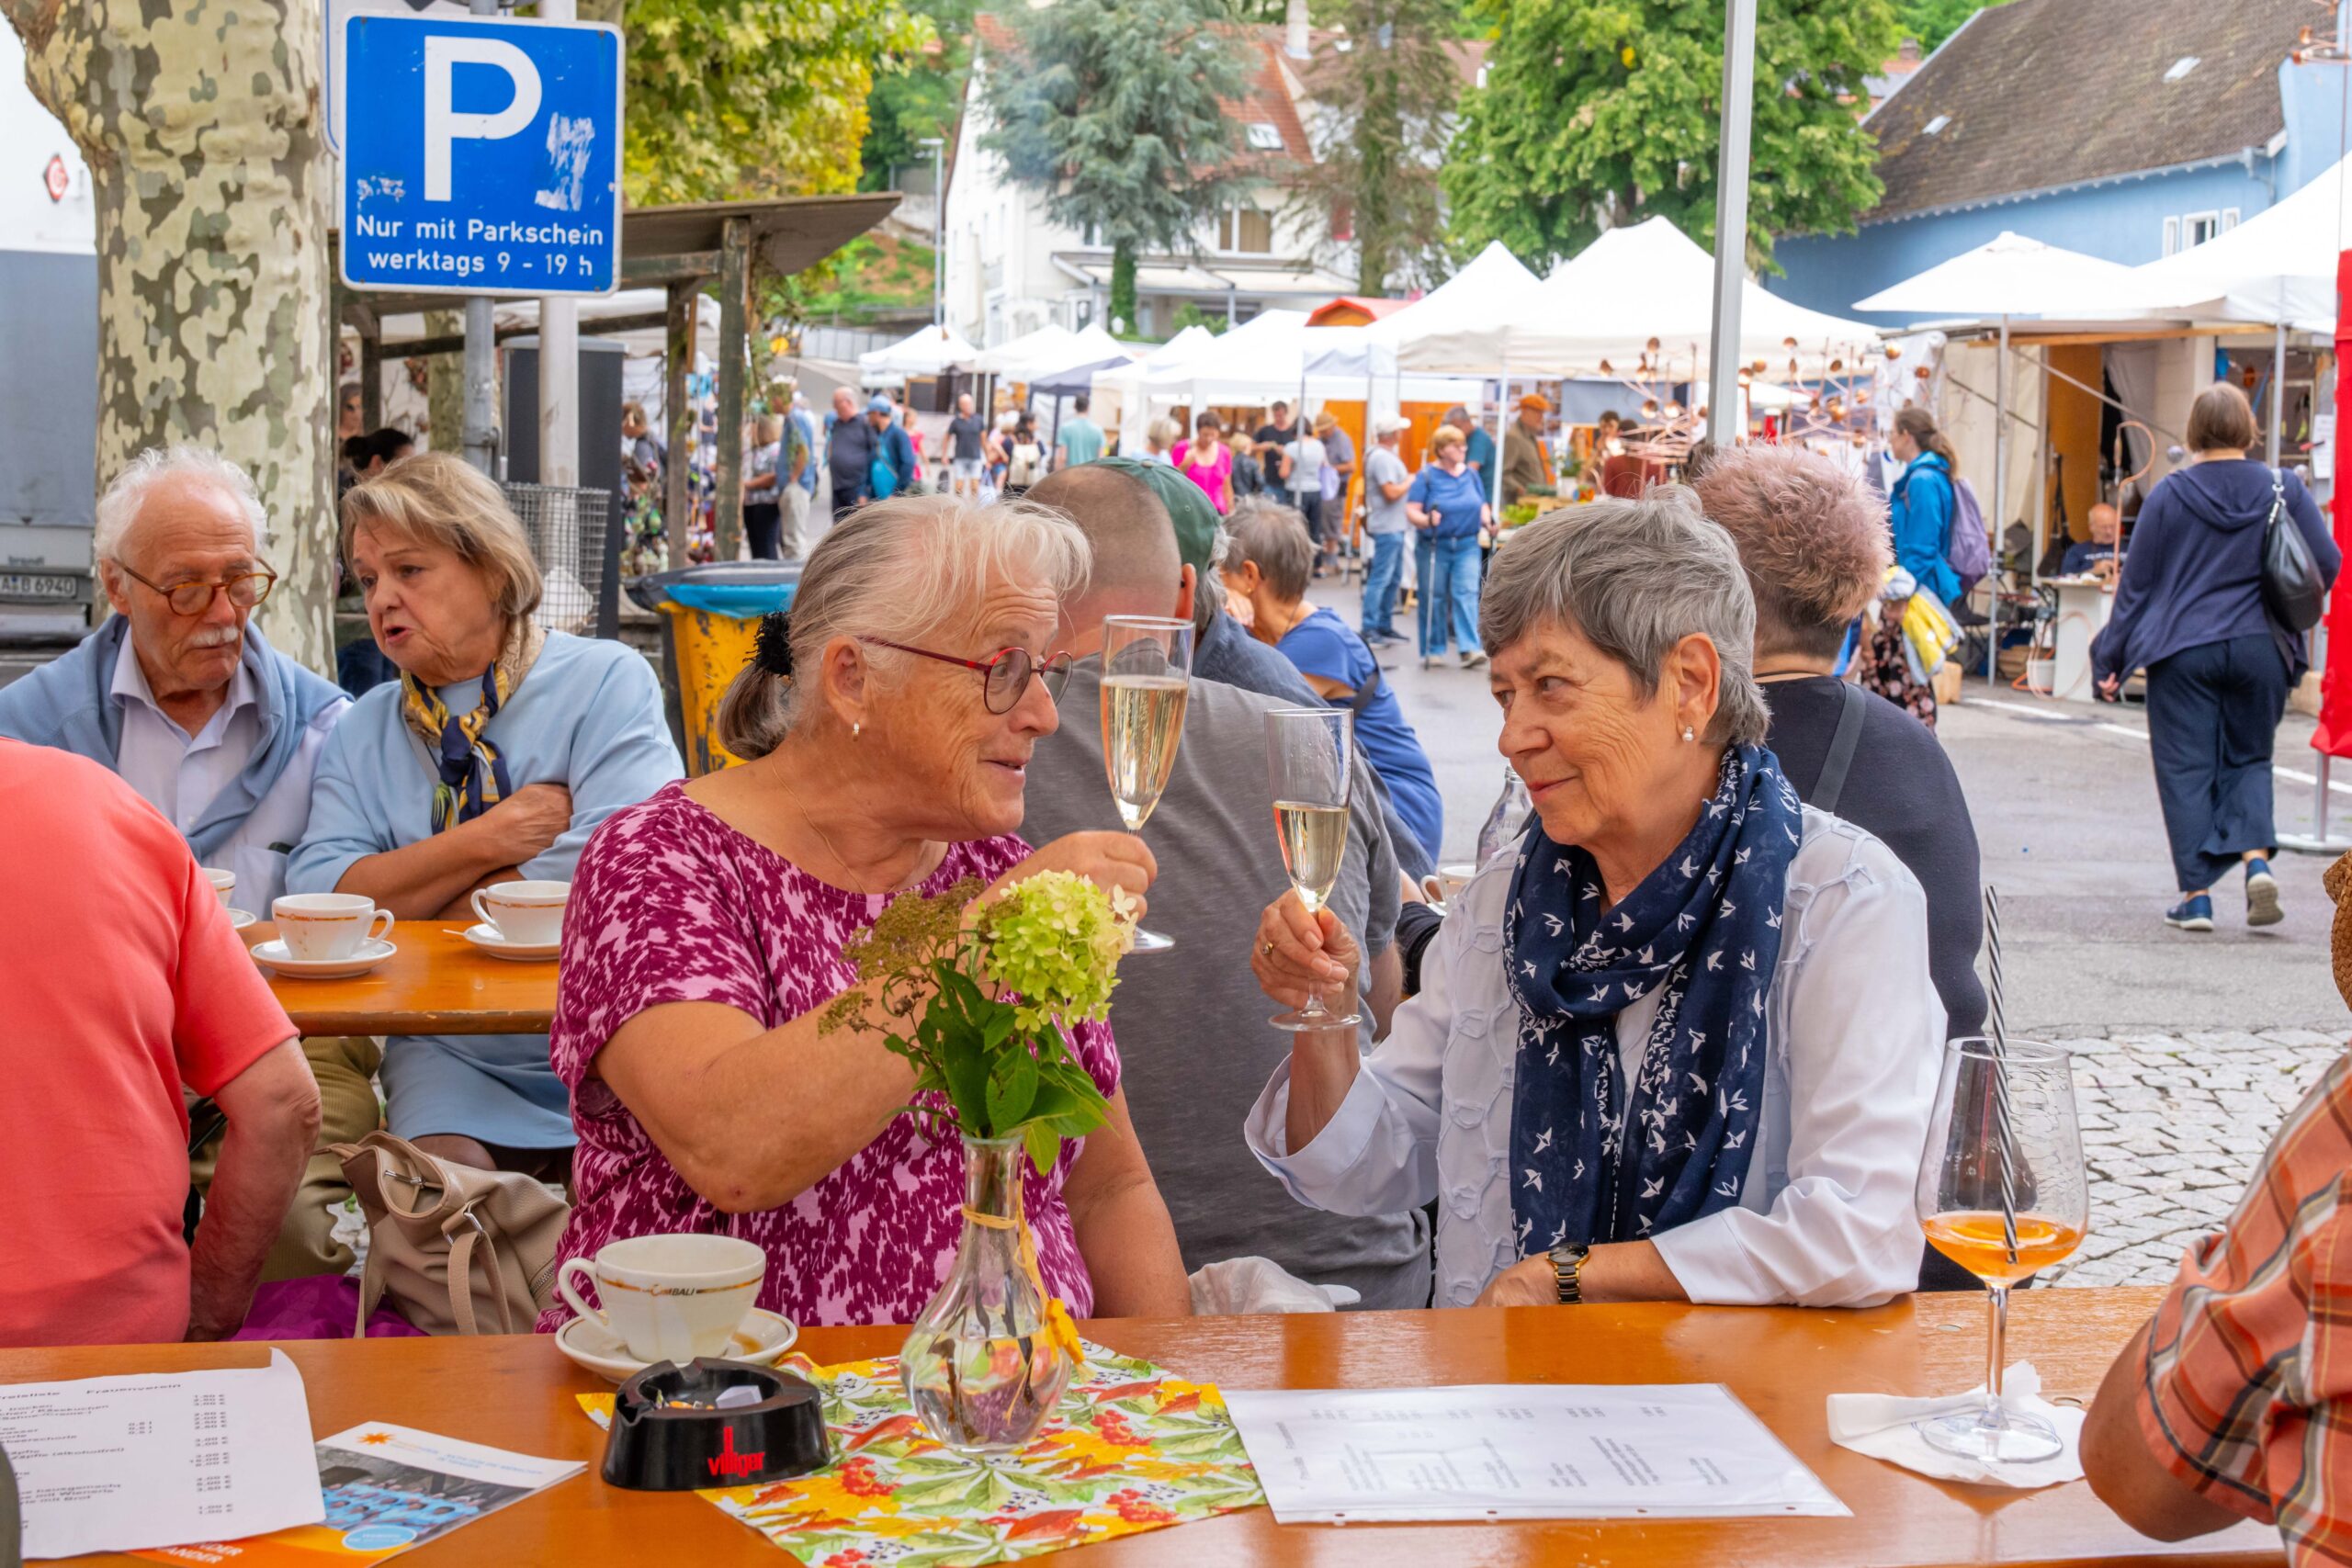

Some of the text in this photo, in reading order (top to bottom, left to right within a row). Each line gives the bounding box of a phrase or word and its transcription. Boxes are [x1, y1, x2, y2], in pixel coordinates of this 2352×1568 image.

[424, 35, 542, 201] P
[356, 215, 604, 245] Nur mit Parkschein
[368, 249, 485, 277] werktags
[497, 252, 511, 273] 9
[545, 254, 568, 276] 19
[579, 255, 593, 276] h
[35, 577, 74, 594] 6940
[707, 1426, 766, 1478] villiger
